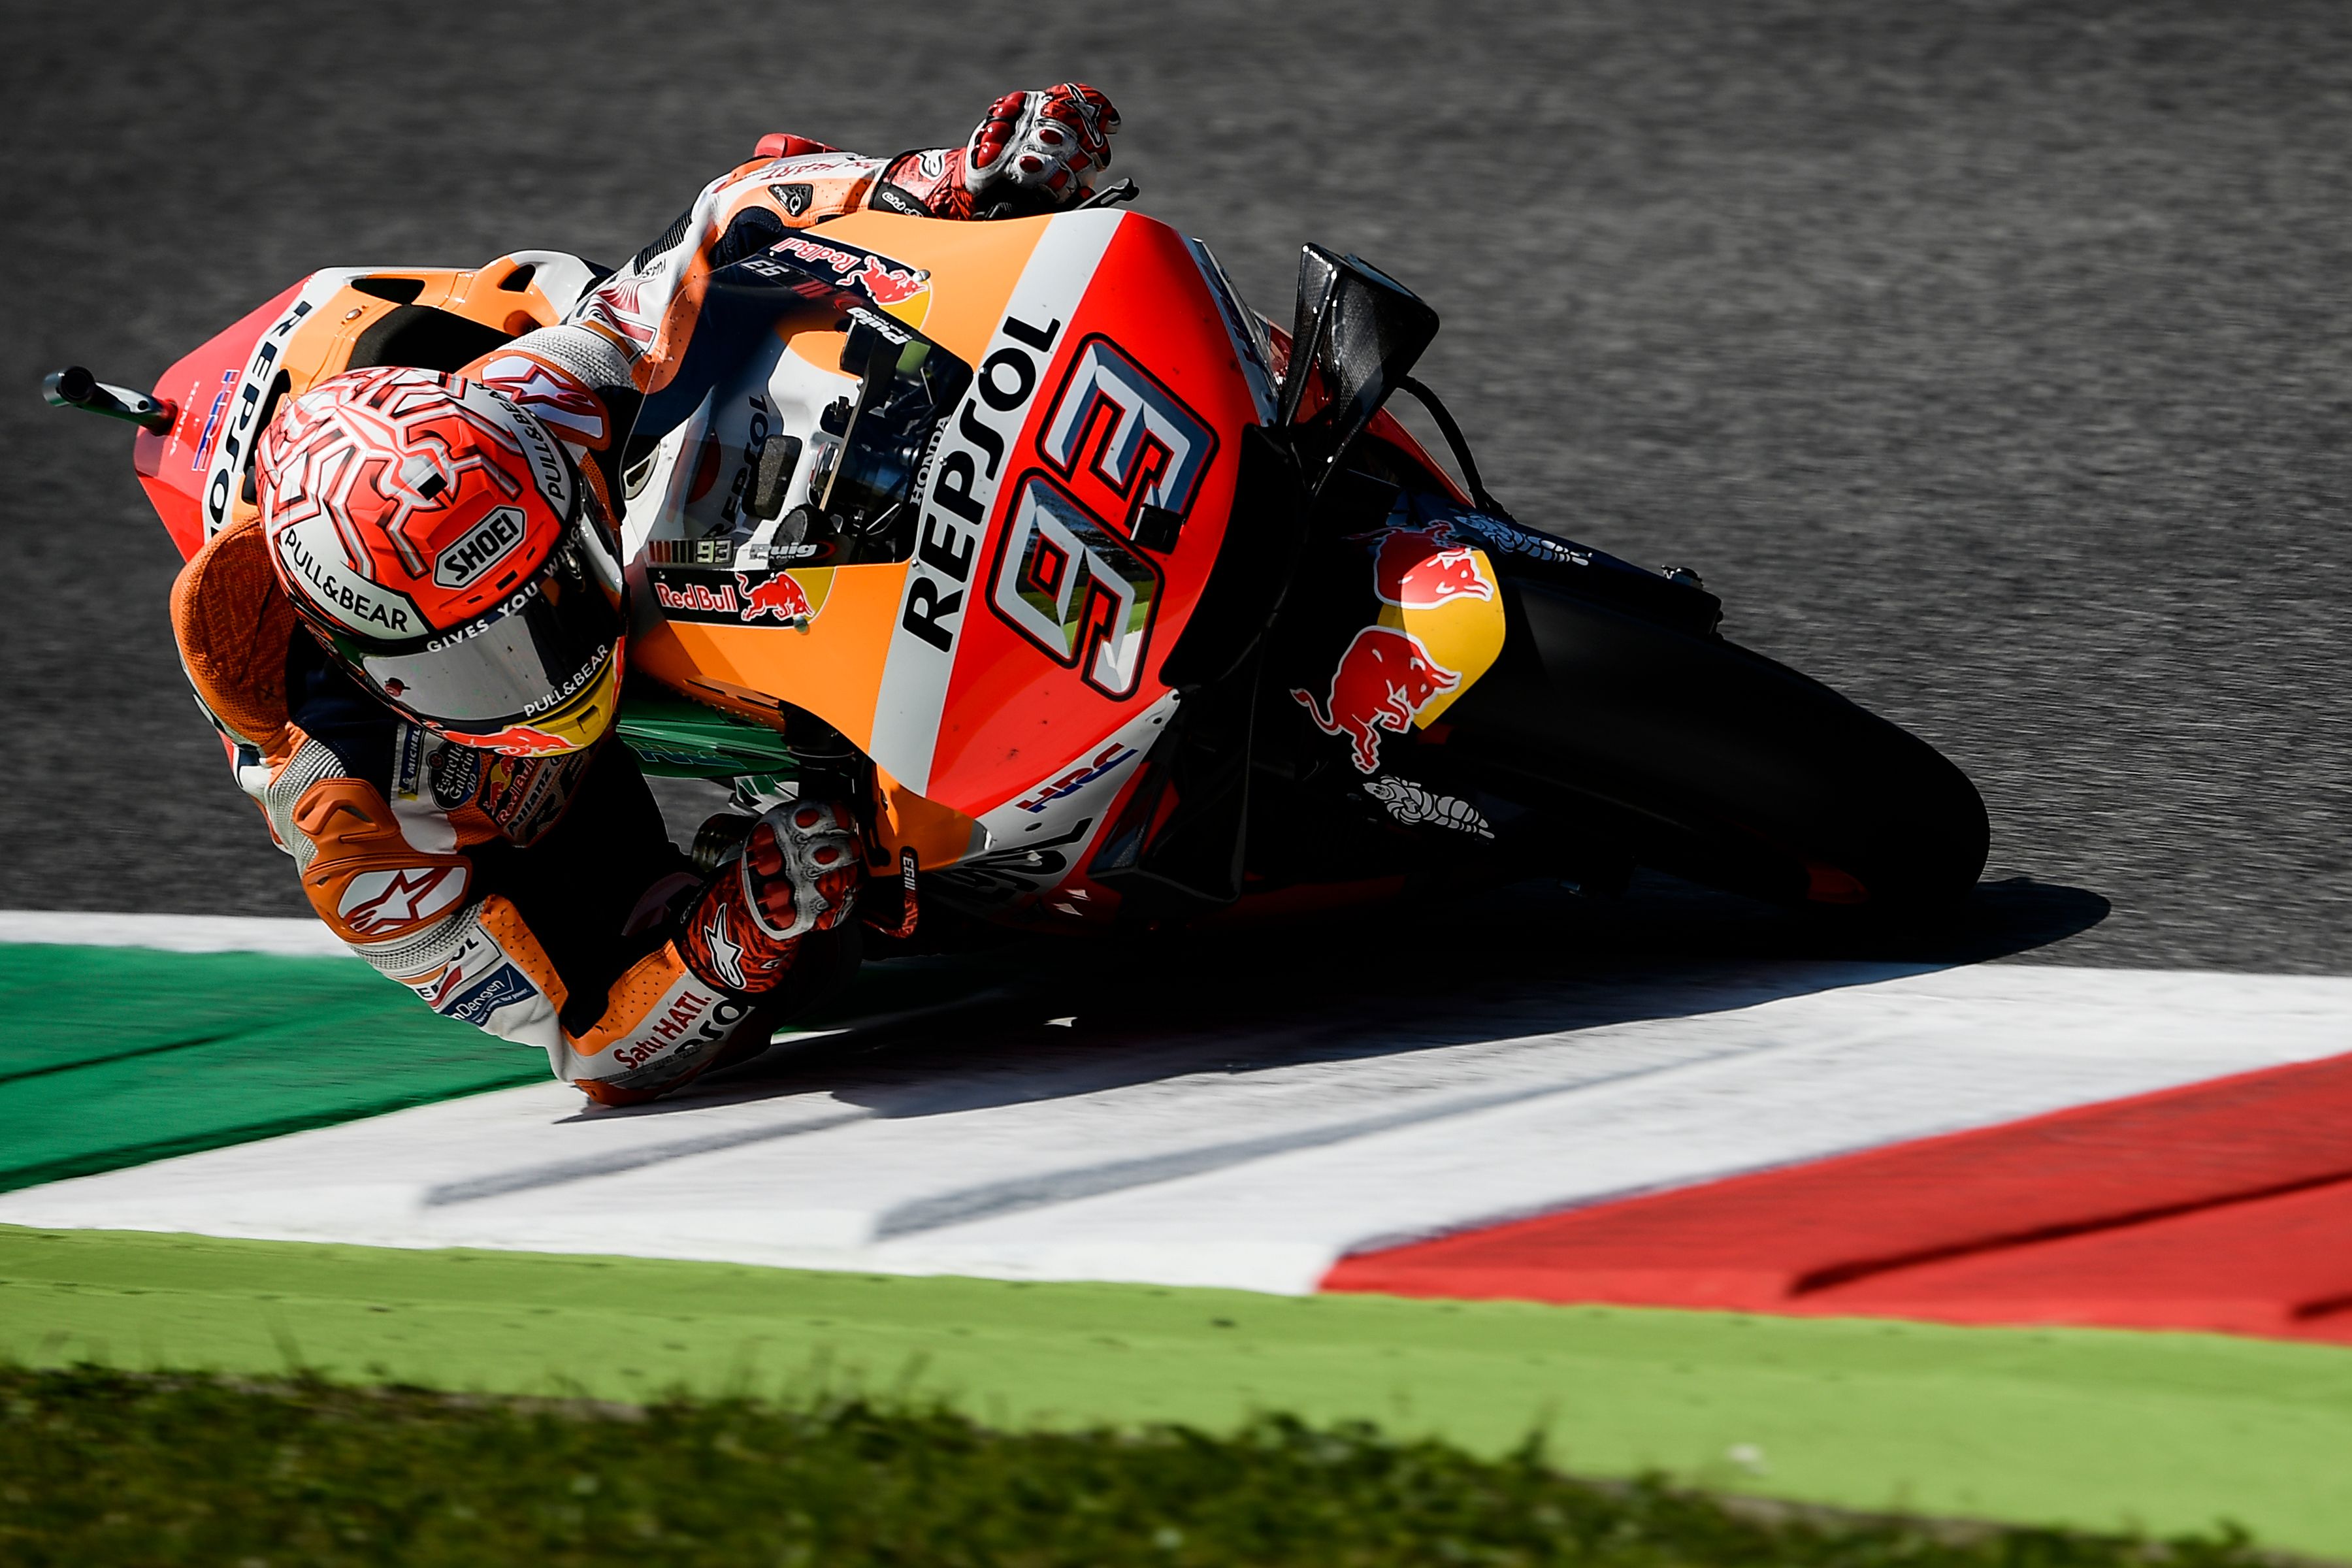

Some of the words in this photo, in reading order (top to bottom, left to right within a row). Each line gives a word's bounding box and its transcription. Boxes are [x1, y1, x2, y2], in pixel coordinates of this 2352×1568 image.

[740, 260, 789, 276] 93
[846, 307, 909, 345] Puig
[191, 369, 240, 471] HRC
[209, 301, 312, 538] REPSO
[471, 383, 566, 501] PULL&BEAR
[902, 316, 1060, 652] REPSOL
[909, 414, 951, 506] HONDA
[444, 513, 519, 582] SHOEI
[696, 538, 734, 563] 93
[749, 542, 817, 557] Puig
[985, 332, 1220, 702] 93
[285, 529, 407, 632] PULL&BEAR
[427, 619, 489, 653] GIVES
[498, 581, 539, 617] YOU
[523, 644, 608, 717] PULL&BEAR
[408, 725, 421, 774] MICHEL
[449, 753, 475, 799] Galicia
[1014, 742, 1139, 814] HRC
[508, 767, 551, 837] Allianz
[613, 1036, 668, 1070] Satu
[652, 990, 712, 1041] HATI.
